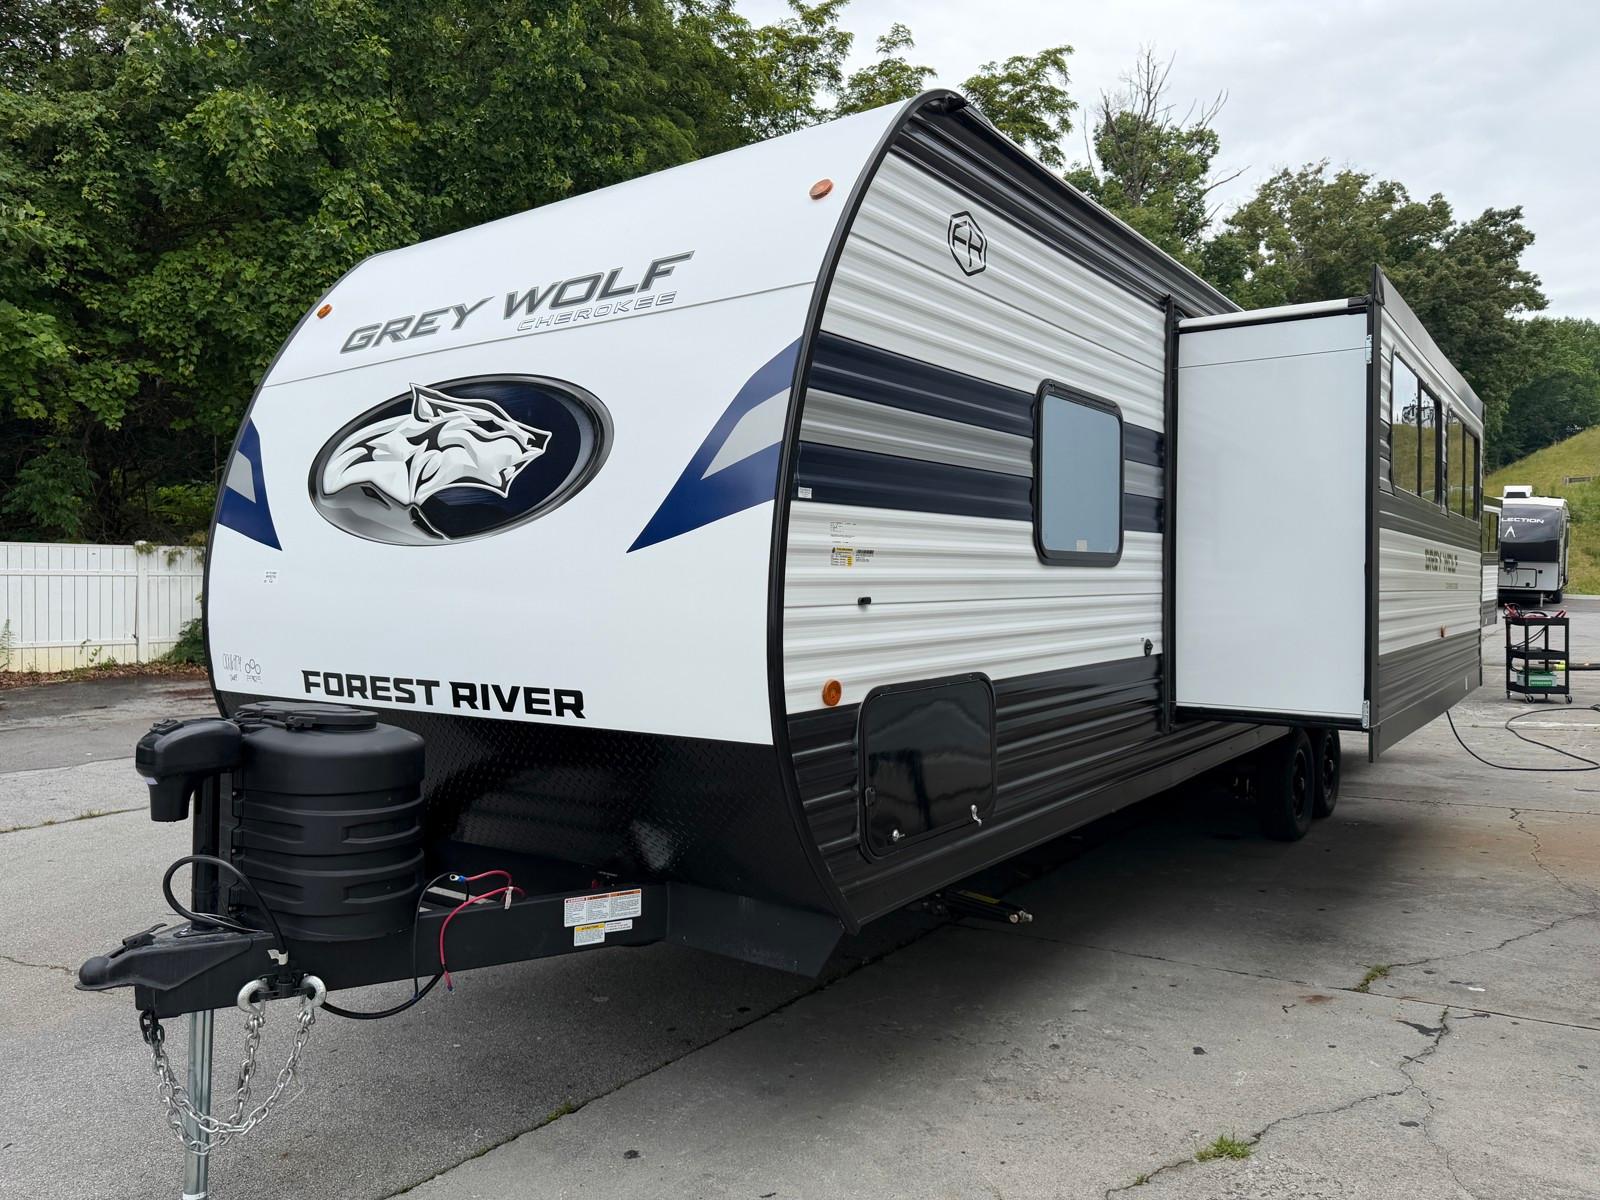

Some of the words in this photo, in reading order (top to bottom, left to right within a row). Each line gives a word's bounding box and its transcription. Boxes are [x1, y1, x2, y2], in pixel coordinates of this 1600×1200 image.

[341, 295, 494, 355] GREY
[502, 250, 694, 320] WOLF
[517, 291, 677, 332] CHEROKEE
[302, 670, 441, 706] FOREST
[449, 681, 586, 719] RIVER
